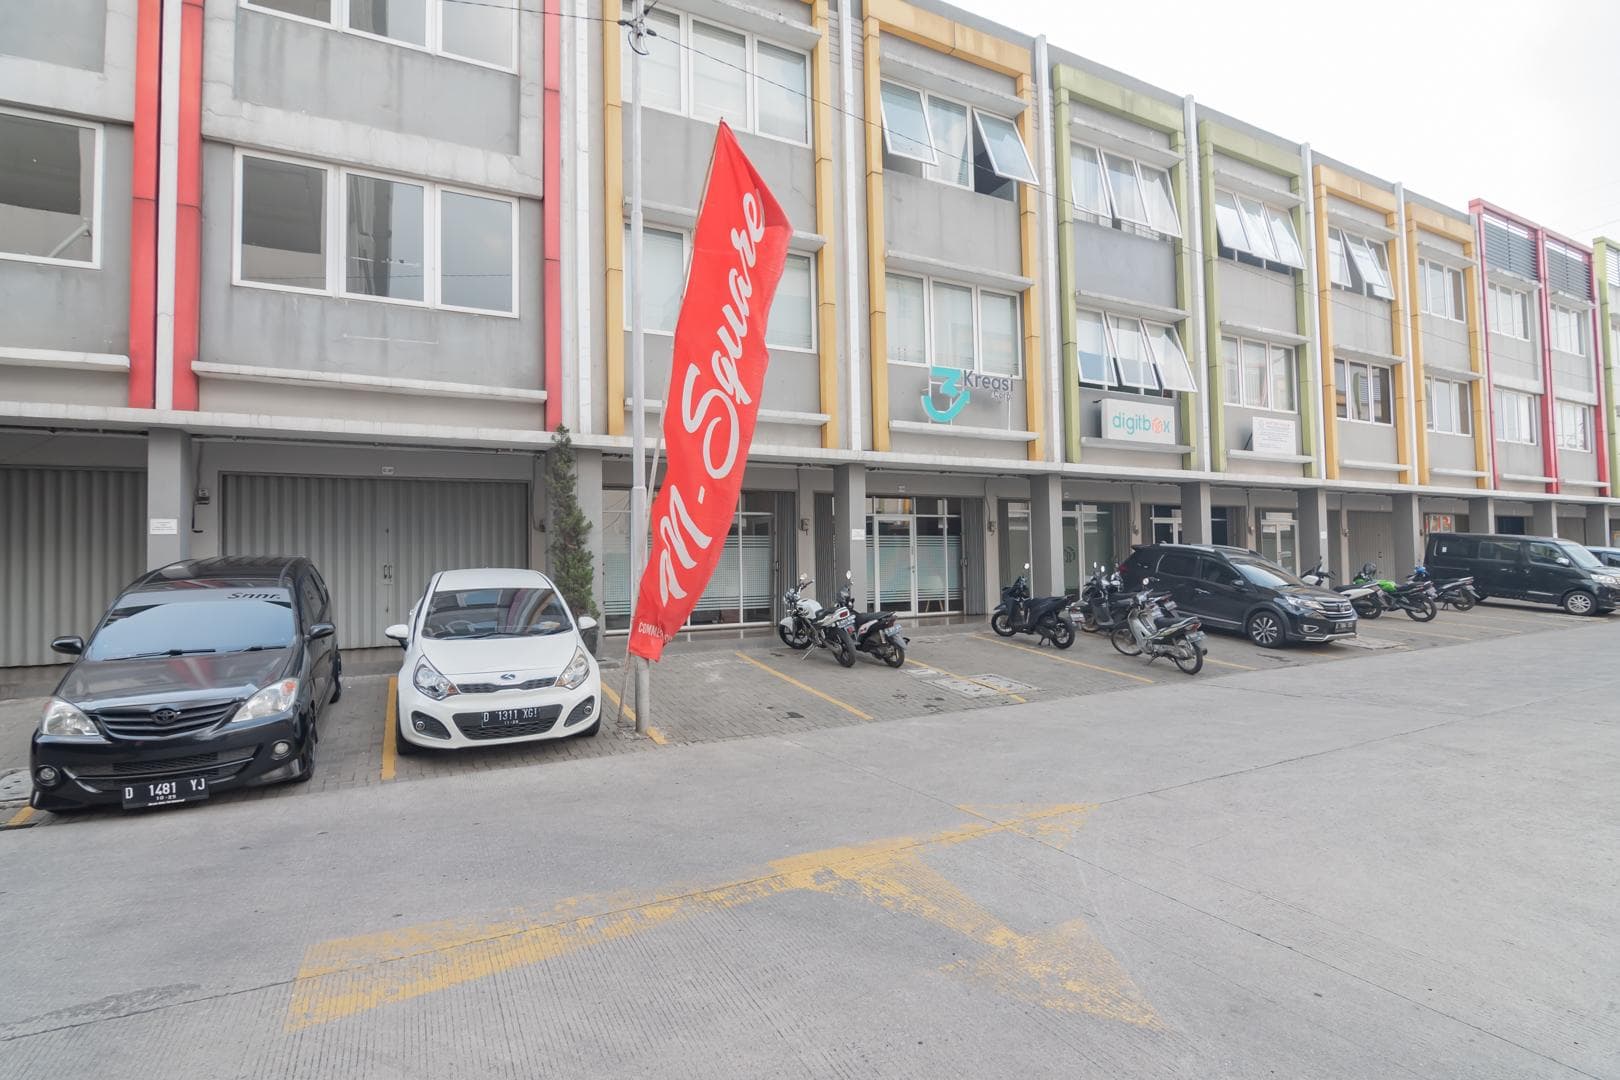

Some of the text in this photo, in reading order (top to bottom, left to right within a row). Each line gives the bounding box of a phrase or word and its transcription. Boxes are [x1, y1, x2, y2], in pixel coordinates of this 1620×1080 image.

[963, 369, 1014, 392] Kreasi
[1112, 411, 1171, 436] digitbox
[483, 711, 490, 722] D
[124, 777, 206, 799] D 1481 YJ
